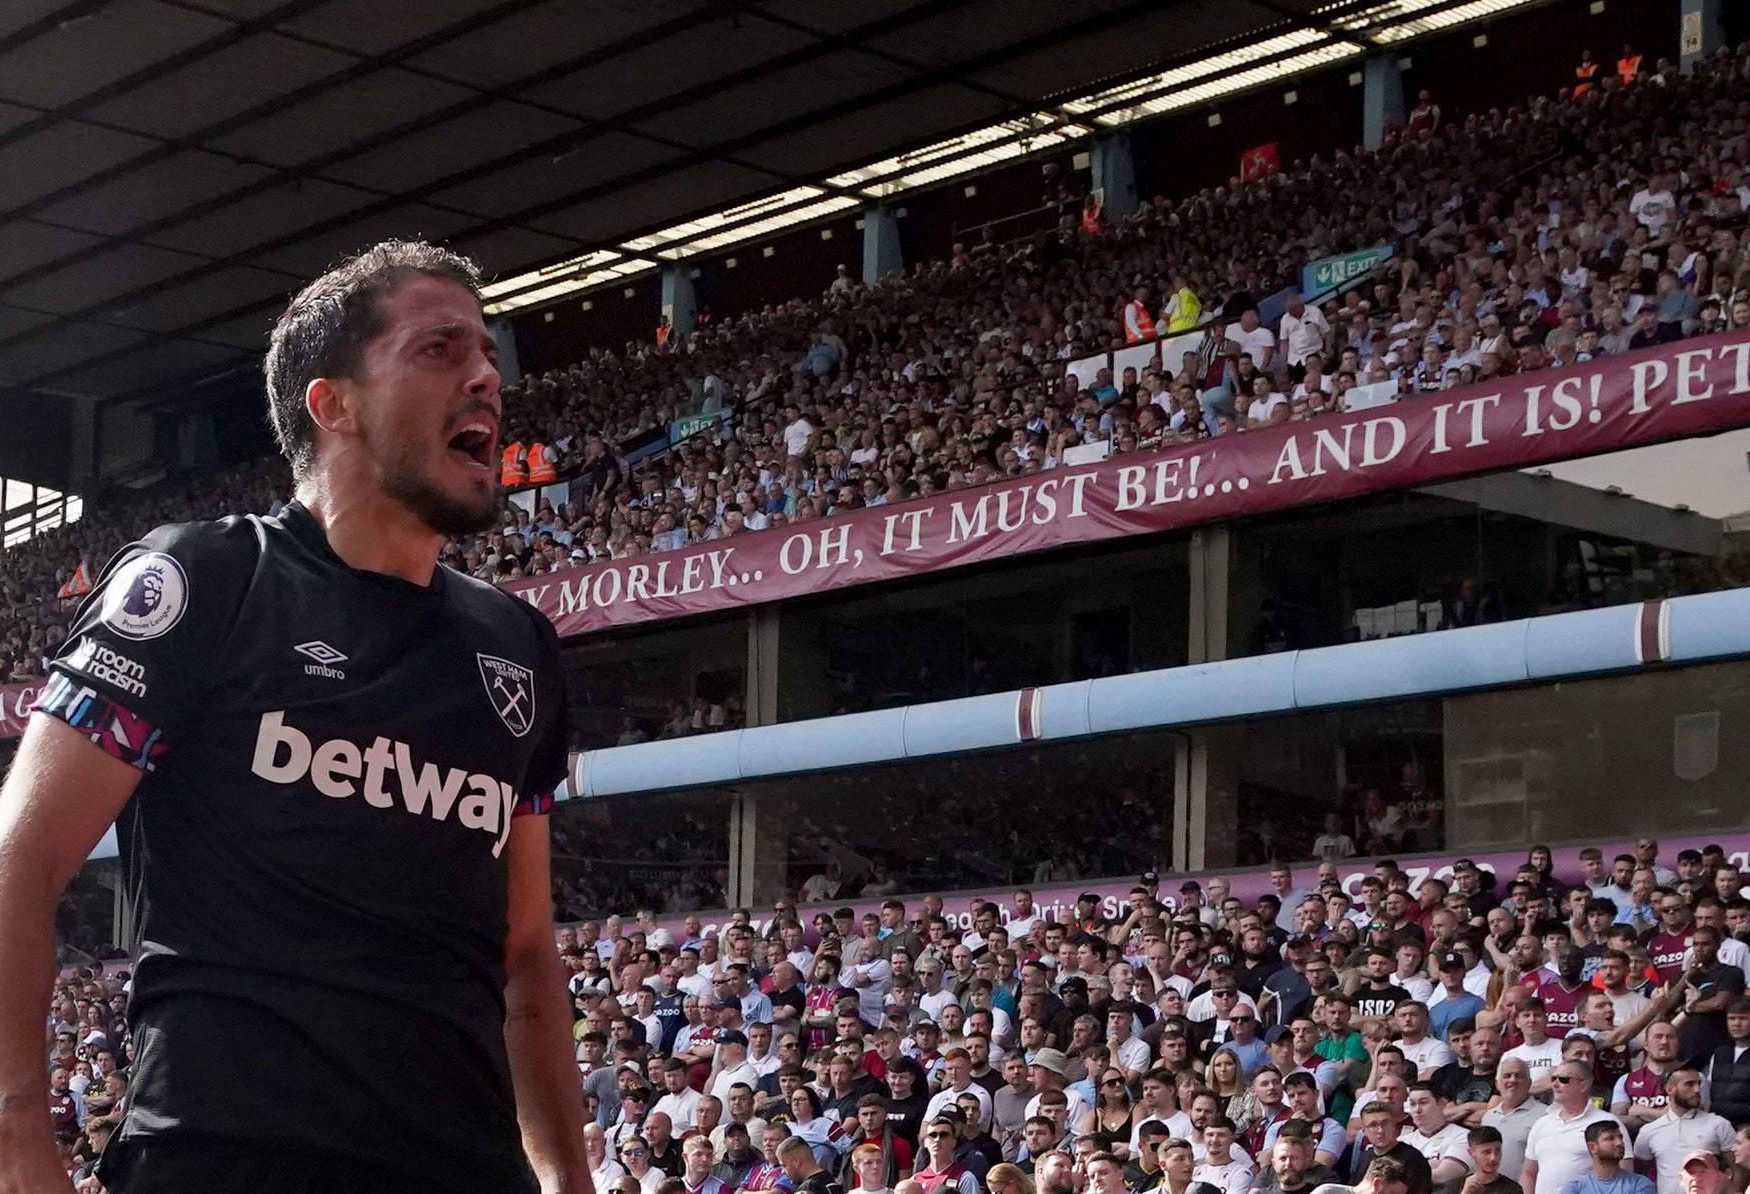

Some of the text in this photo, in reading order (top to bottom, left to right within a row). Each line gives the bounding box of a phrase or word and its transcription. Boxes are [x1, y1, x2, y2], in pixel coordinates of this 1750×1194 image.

[555, 548, 763, 616] MORLEY...
[779, 524, 864, 575] OH,
[880, 507, 935, 556] IT
[946, 472, 1099, 543] MUST
[1114, 455, 1249, 513] BE!...
[1267, 416, 1407, 484] AND
[1430, 394, 1501, 454] IT
[1522, 374, 1603, 437] IS!
[87, 659, 147, 698] racism
[95, 646, 146, 680] room
[304, 664, 345, 680] umbro
[482, 659, 527, 681] WEST HAM
[251, 710, 519, 859] betway
